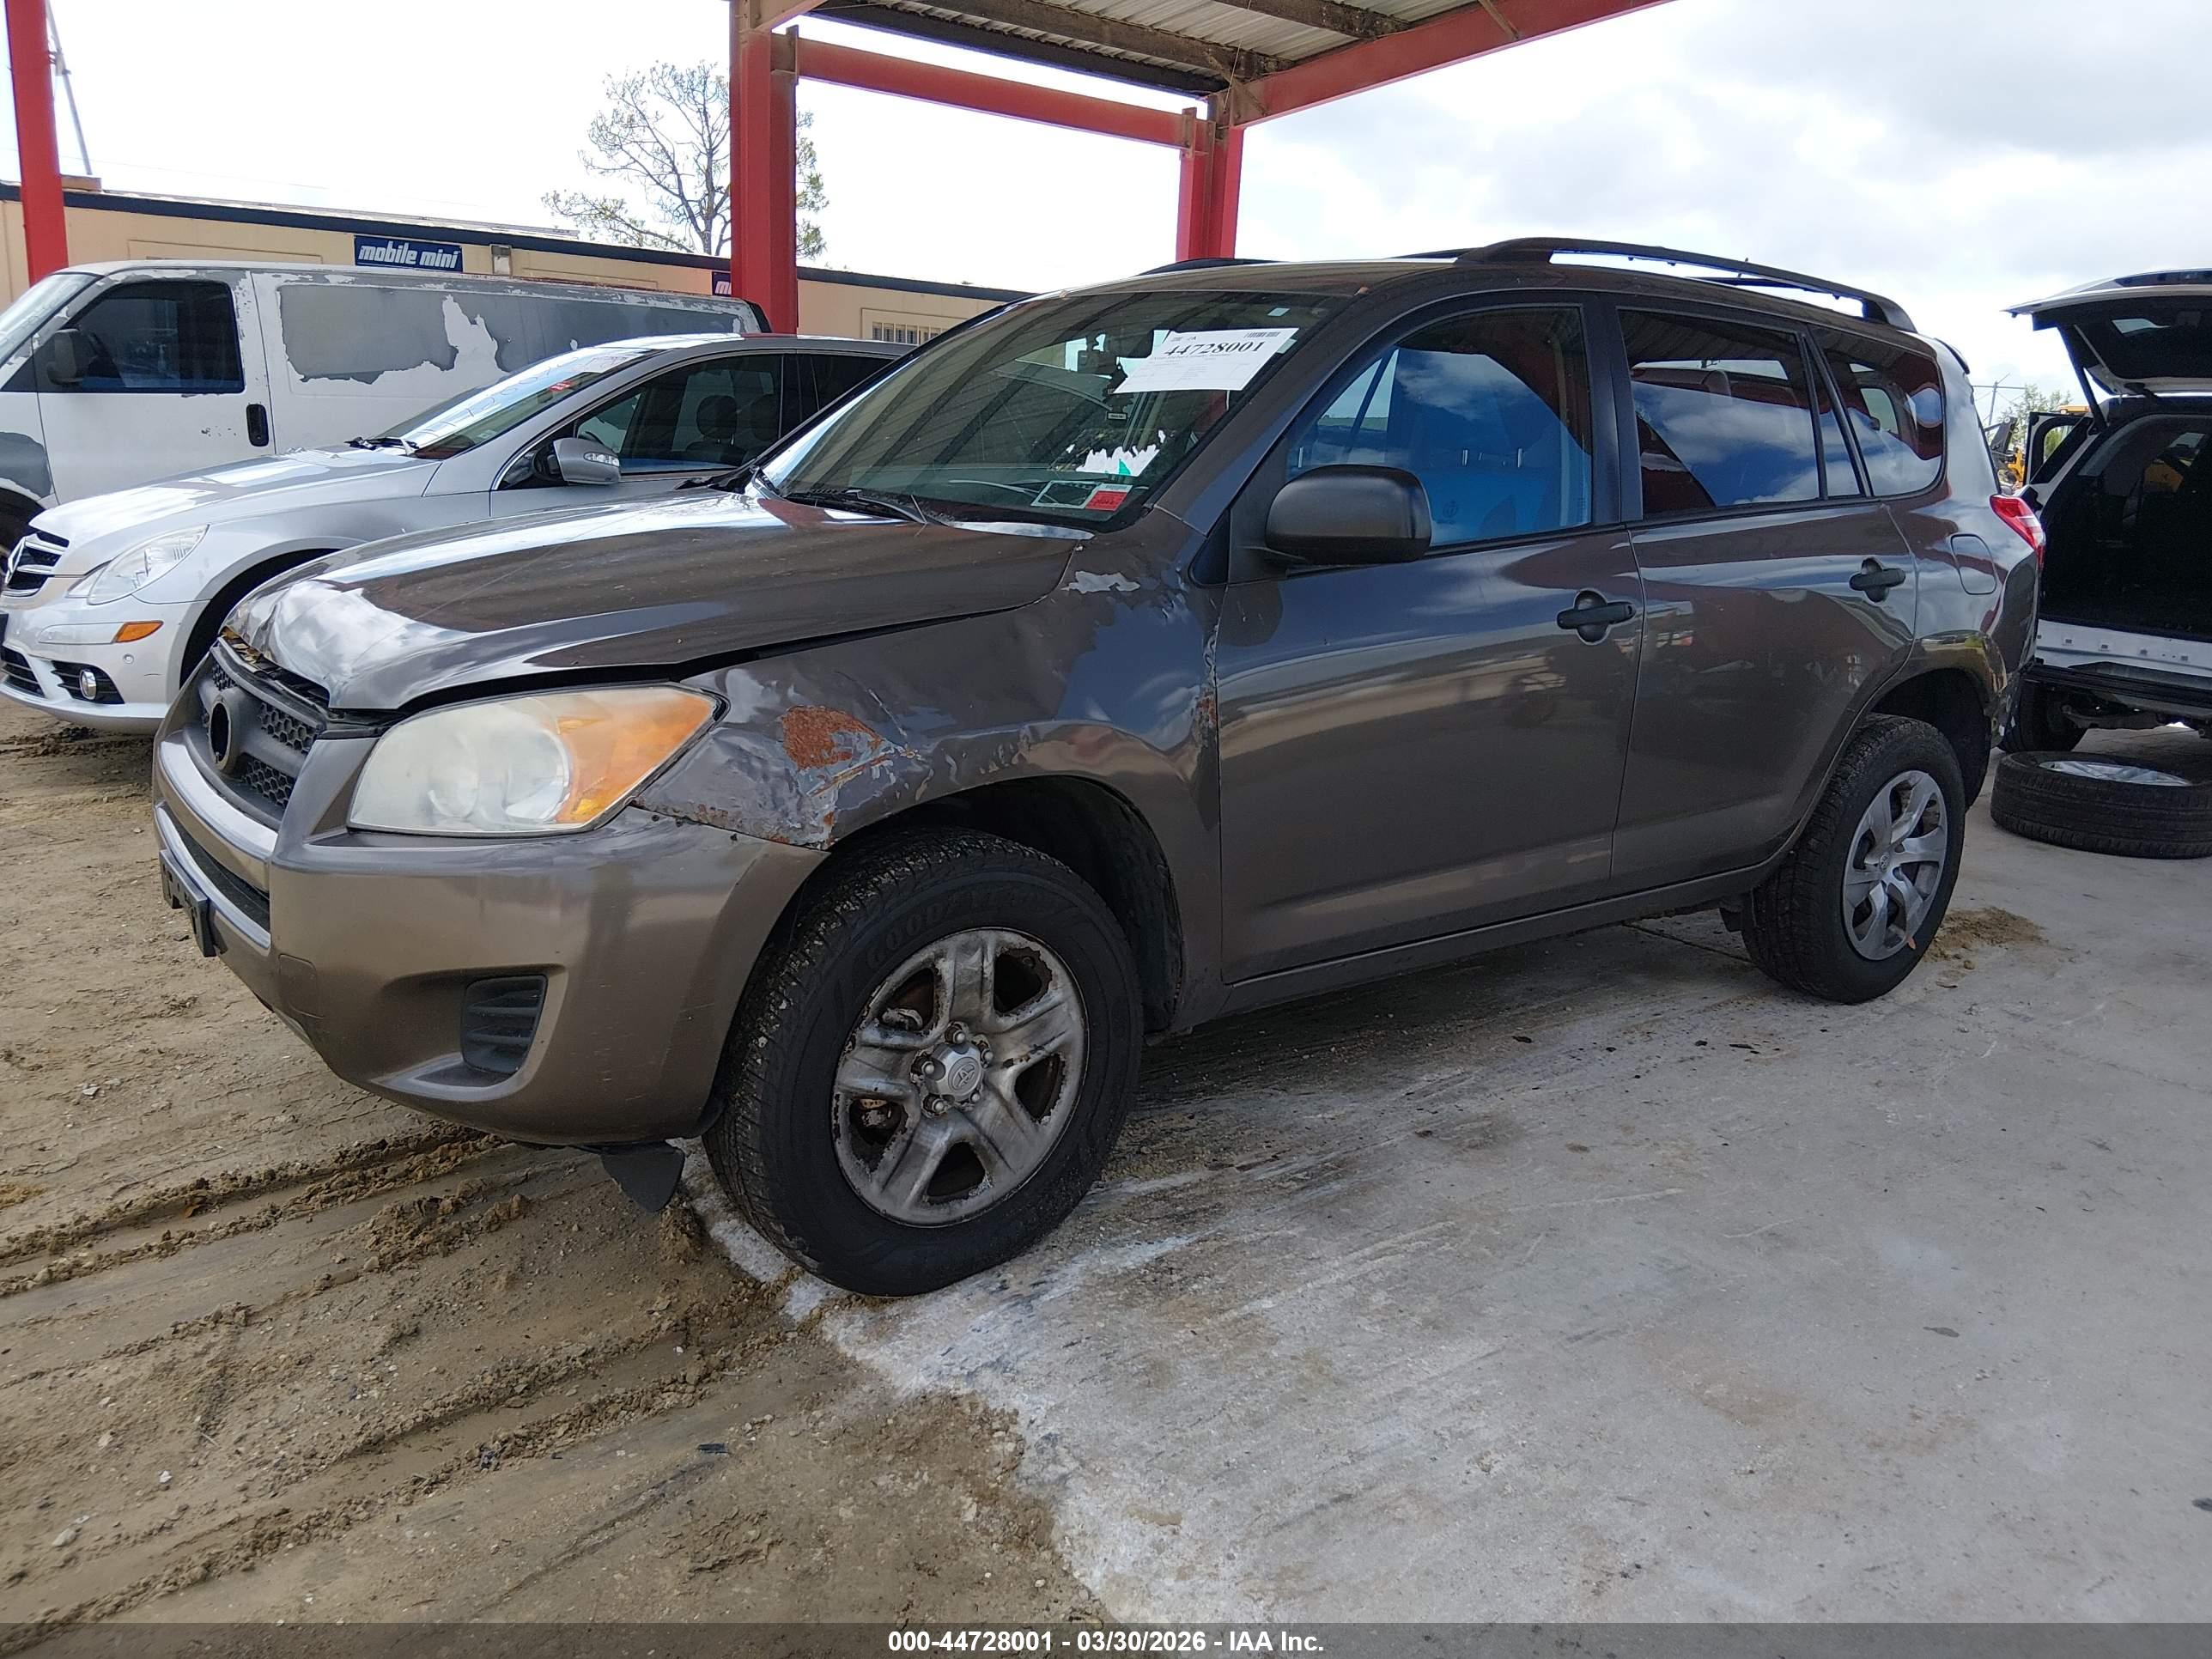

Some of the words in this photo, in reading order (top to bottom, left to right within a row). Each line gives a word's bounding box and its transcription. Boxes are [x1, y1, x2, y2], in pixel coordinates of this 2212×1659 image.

[358, 240, 416, 265] mobile
[419, 248, 459, 269] mini
[1164, 341, 1266, 356] 44728001
